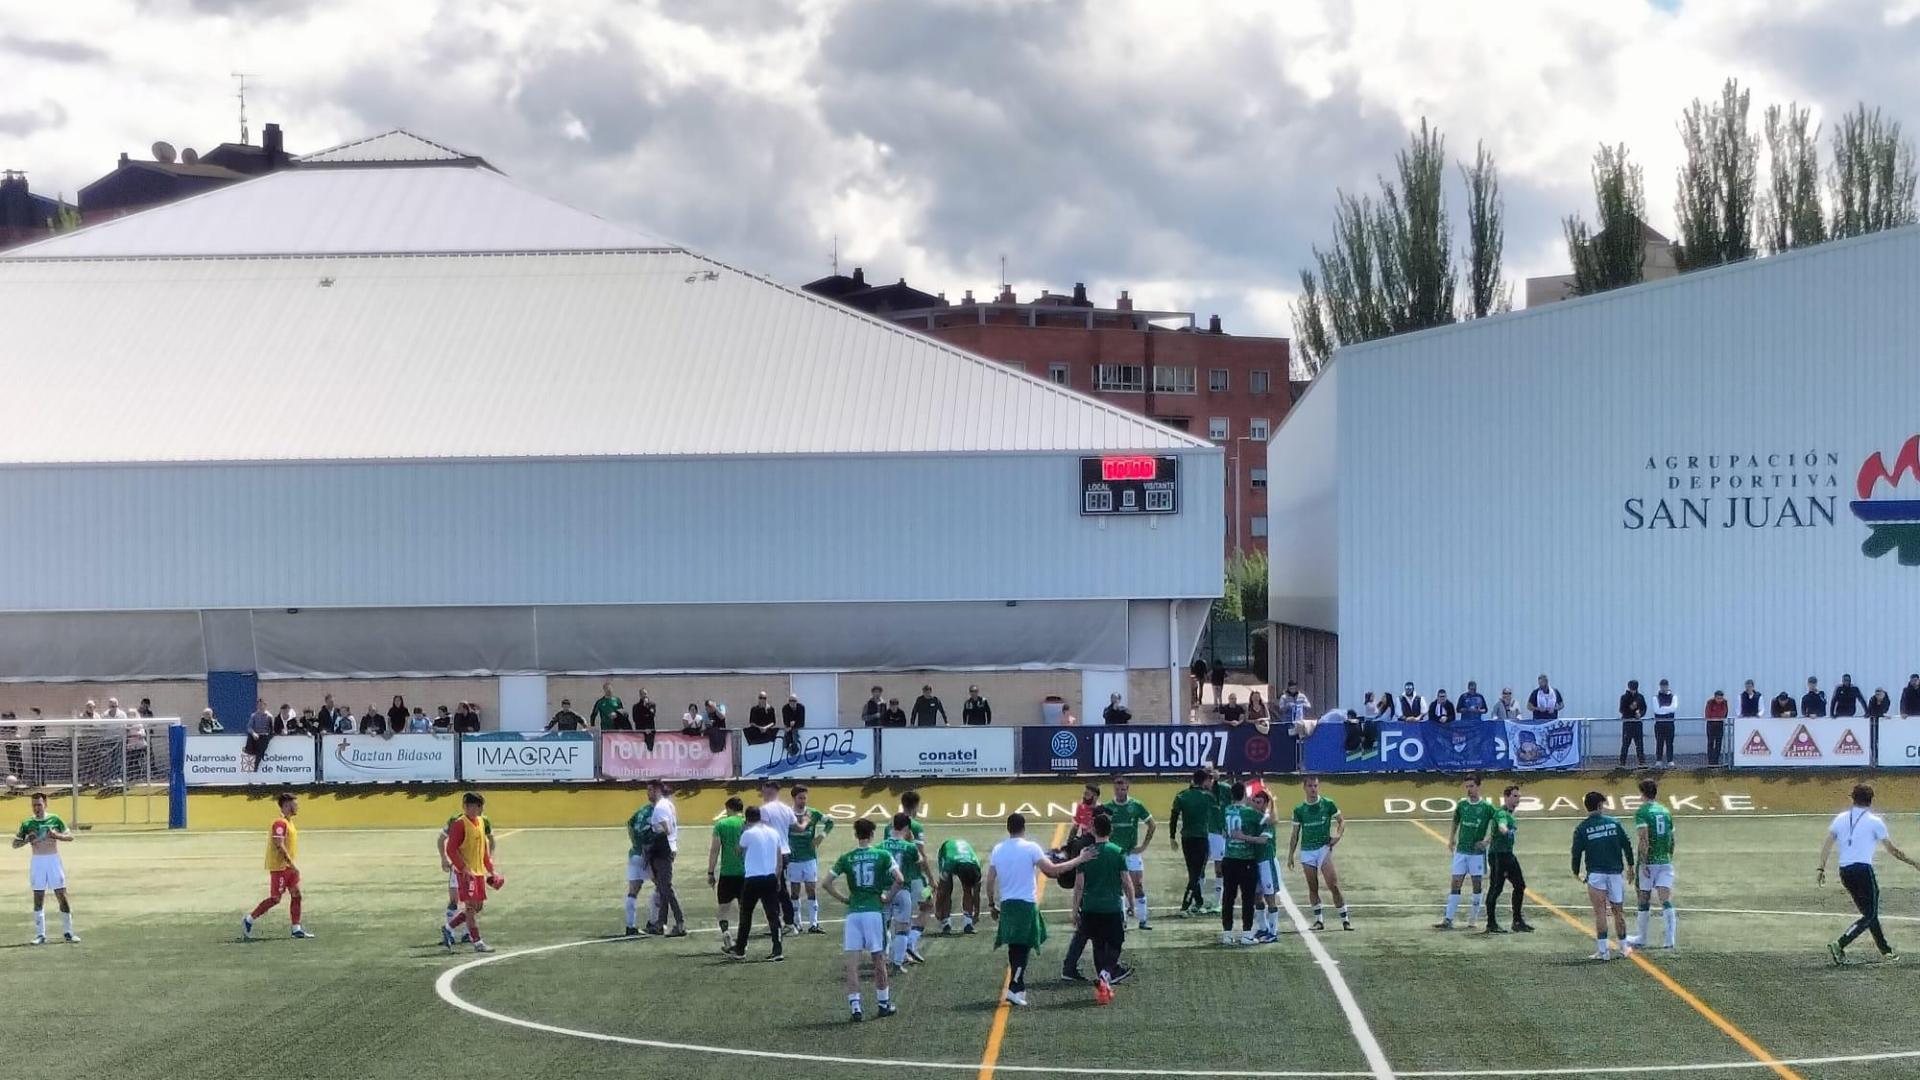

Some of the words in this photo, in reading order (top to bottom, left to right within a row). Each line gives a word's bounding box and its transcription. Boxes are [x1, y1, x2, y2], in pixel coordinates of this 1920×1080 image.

[1645, 449, 1840, 470] AGRUPACIÓN
[1087, 483, 1111, 491] LOCAL
[1668, 474, 1838, 490] DEPORTIVA
[1623, 497, 1711, 530] SAN
[1723, 496, 1838, 529] JUAN
[186, 753, 237, 762] Nafarroako
[261, 753, 304, 762] Gobierno
[351, 749, 393, 762] Baztan
[397, 748, 442, 761] Bidasoa
[477, 746, 579, 766] IMAGRAF
[918, 748, 977, 761] conatel
[1093, 731, 1229, 768] IMPULSO27
[191, 765, 237, 773] Gobernua
[261, 765, 274, 773] de
[276, 765, 312, 773] Navarra
[946, 802, 1077, 818] JUAN
[1669, 794, 1769, 811] K.E.
[851, 861, 876, 888] 16
